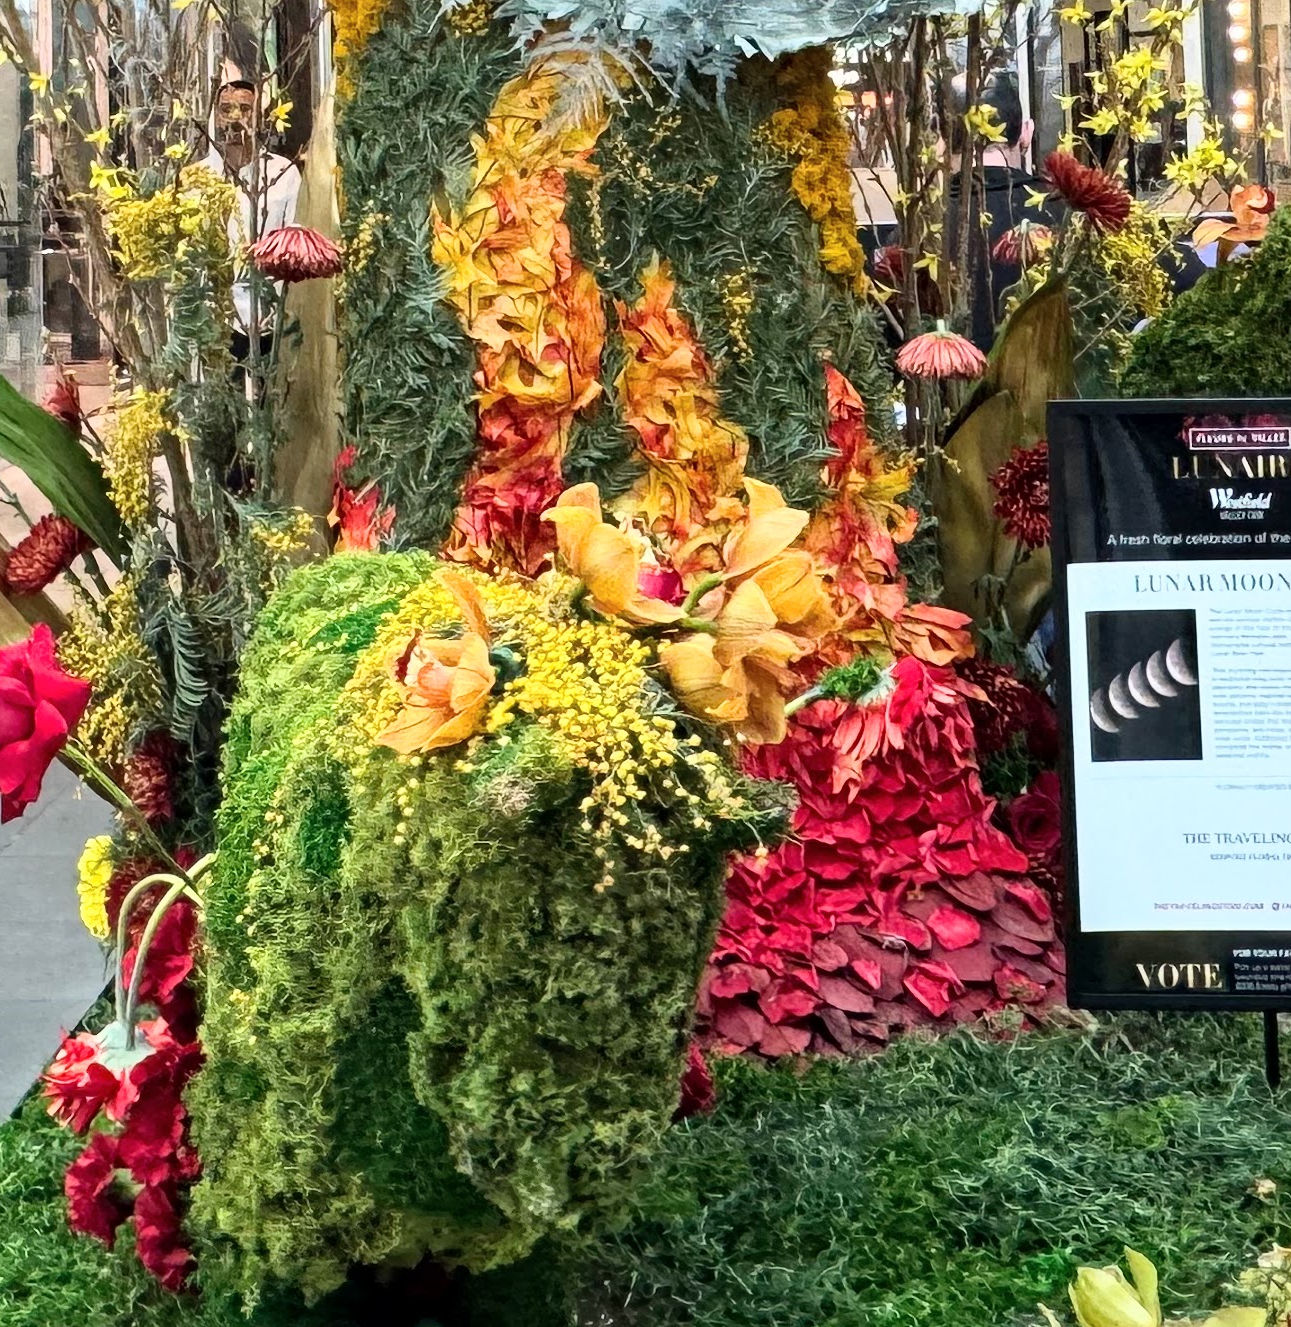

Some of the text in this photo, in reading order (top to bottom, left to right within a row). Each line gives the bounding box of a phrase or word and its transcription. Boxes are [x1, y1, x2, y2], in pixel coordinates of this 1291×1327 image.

[1106, 534, 1117, 545] A
[1153, 533, 1183, 545] floral
[1185, 532, 1251, 545] celebration
[1254, 532, 1266, 544] of
[1270, 532, 1291, 543] the
[1134, 573, 1214, 592] LUNAR
[1219, 572, 1291, 592] MOON
[1183, 832, 1211, 844] THE
[1135, 962, 1223, 989] VOTE
